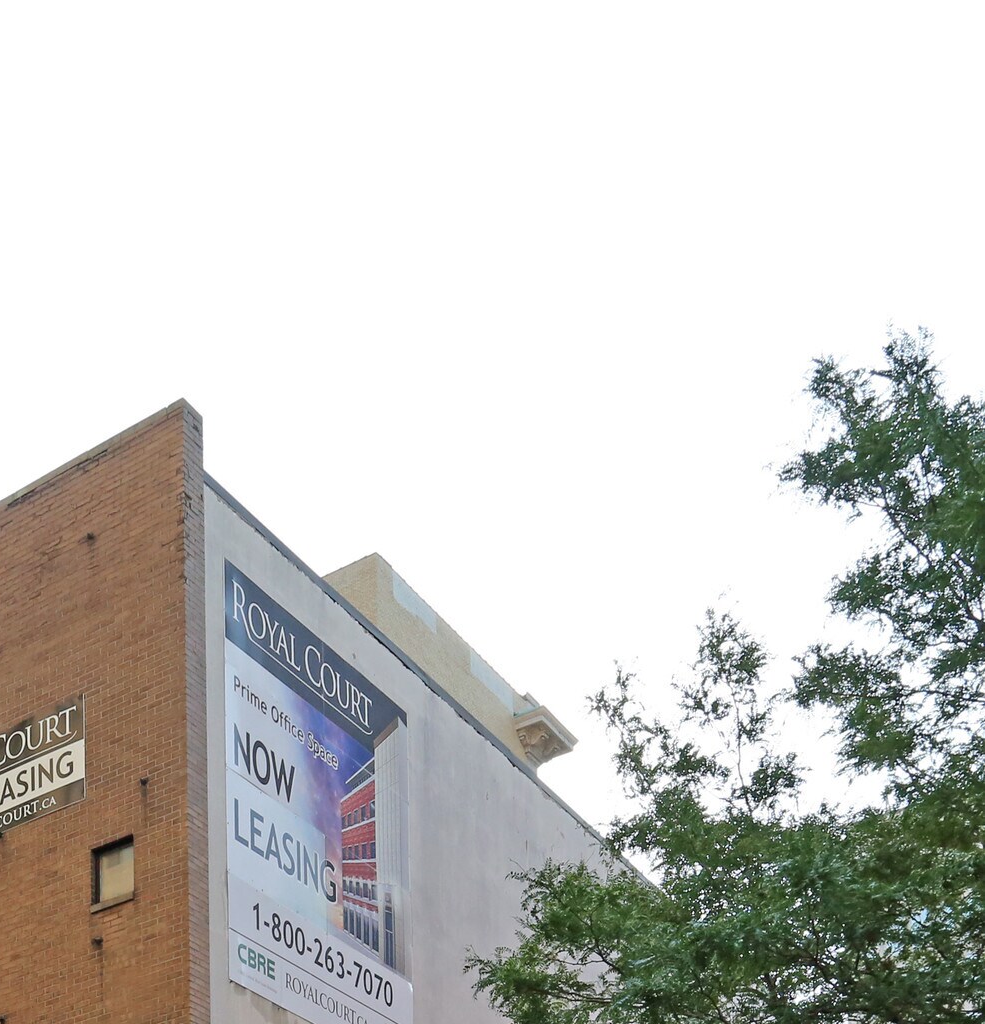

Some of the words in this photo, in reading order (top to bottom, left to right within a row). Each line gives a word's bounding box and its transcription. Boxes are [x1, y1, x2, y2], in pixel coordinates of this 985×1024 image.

[231, 578, 301, 672] ROYAL
[304, 645, 373, 732] COURT
[233, 674, 268, 715] Prime
[271, 705, 305, 745] Office
[307, 731, 339, 771] Space
[233, 722, 296, 803] NOW
[233, 796, 337, 904] LEASING
[237, 942, 277, 981] CBRE
[252, 902, 394, 1008] 1-800-263-7070
